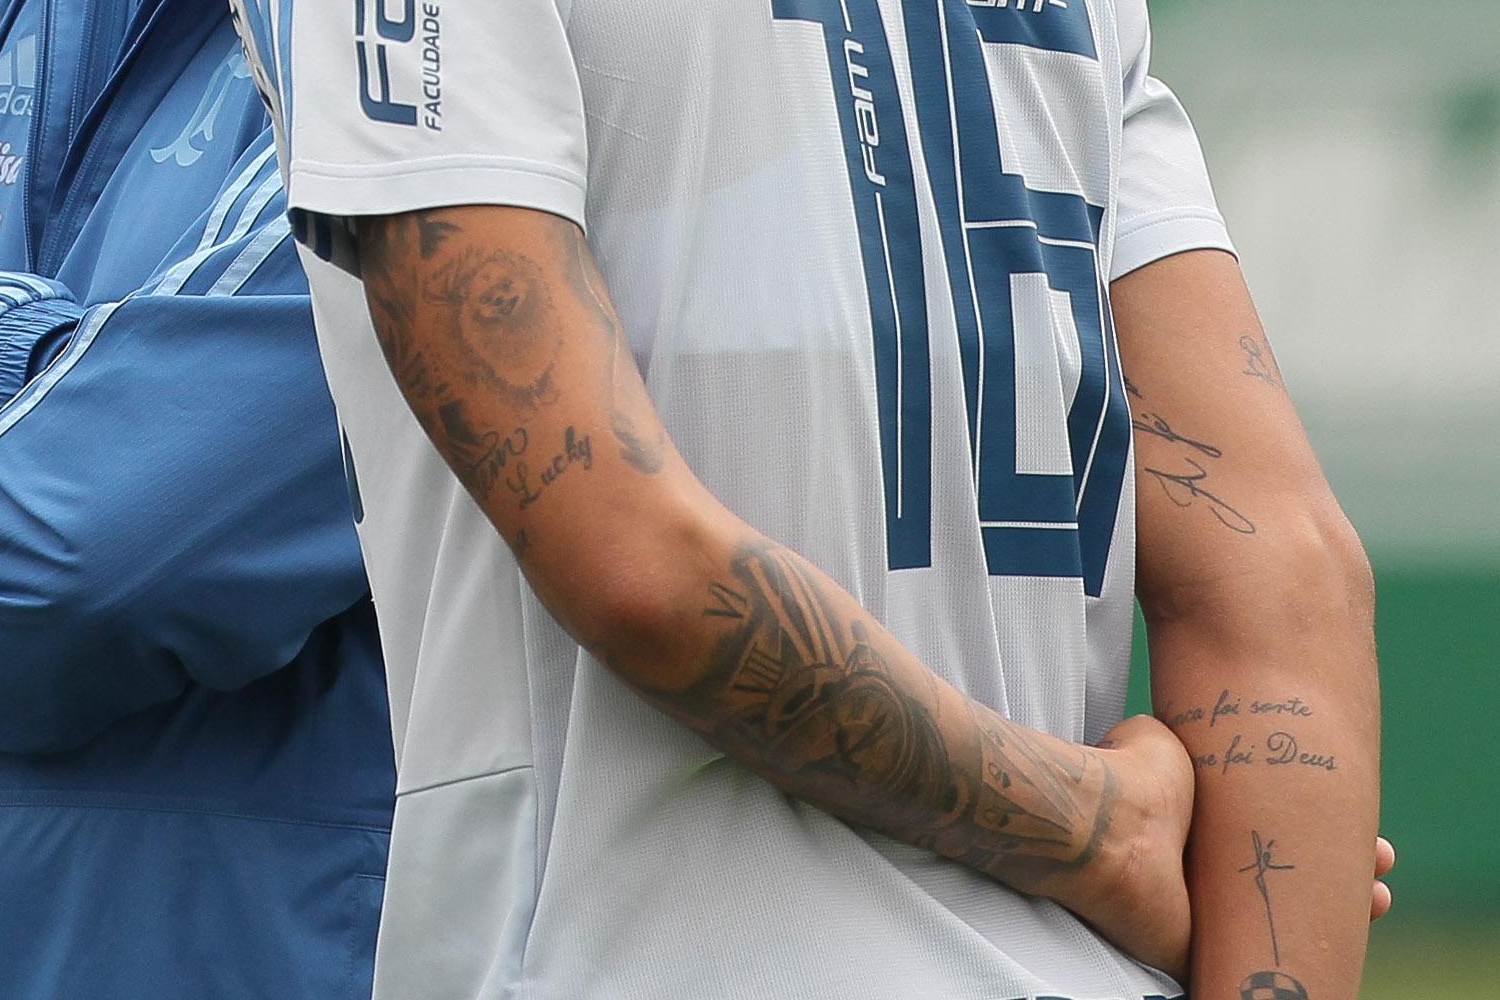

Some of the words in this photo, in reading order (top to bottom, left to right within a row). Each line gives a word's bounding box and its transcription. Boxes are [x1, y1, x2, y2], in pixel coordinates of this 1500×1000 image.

[421, 3, 442, 132] FACULDADE
[1210, 689, 1241, 728] foi
[1222, 734, 1253, 775] foi
[1266, 731, 1337, 771] Deus
